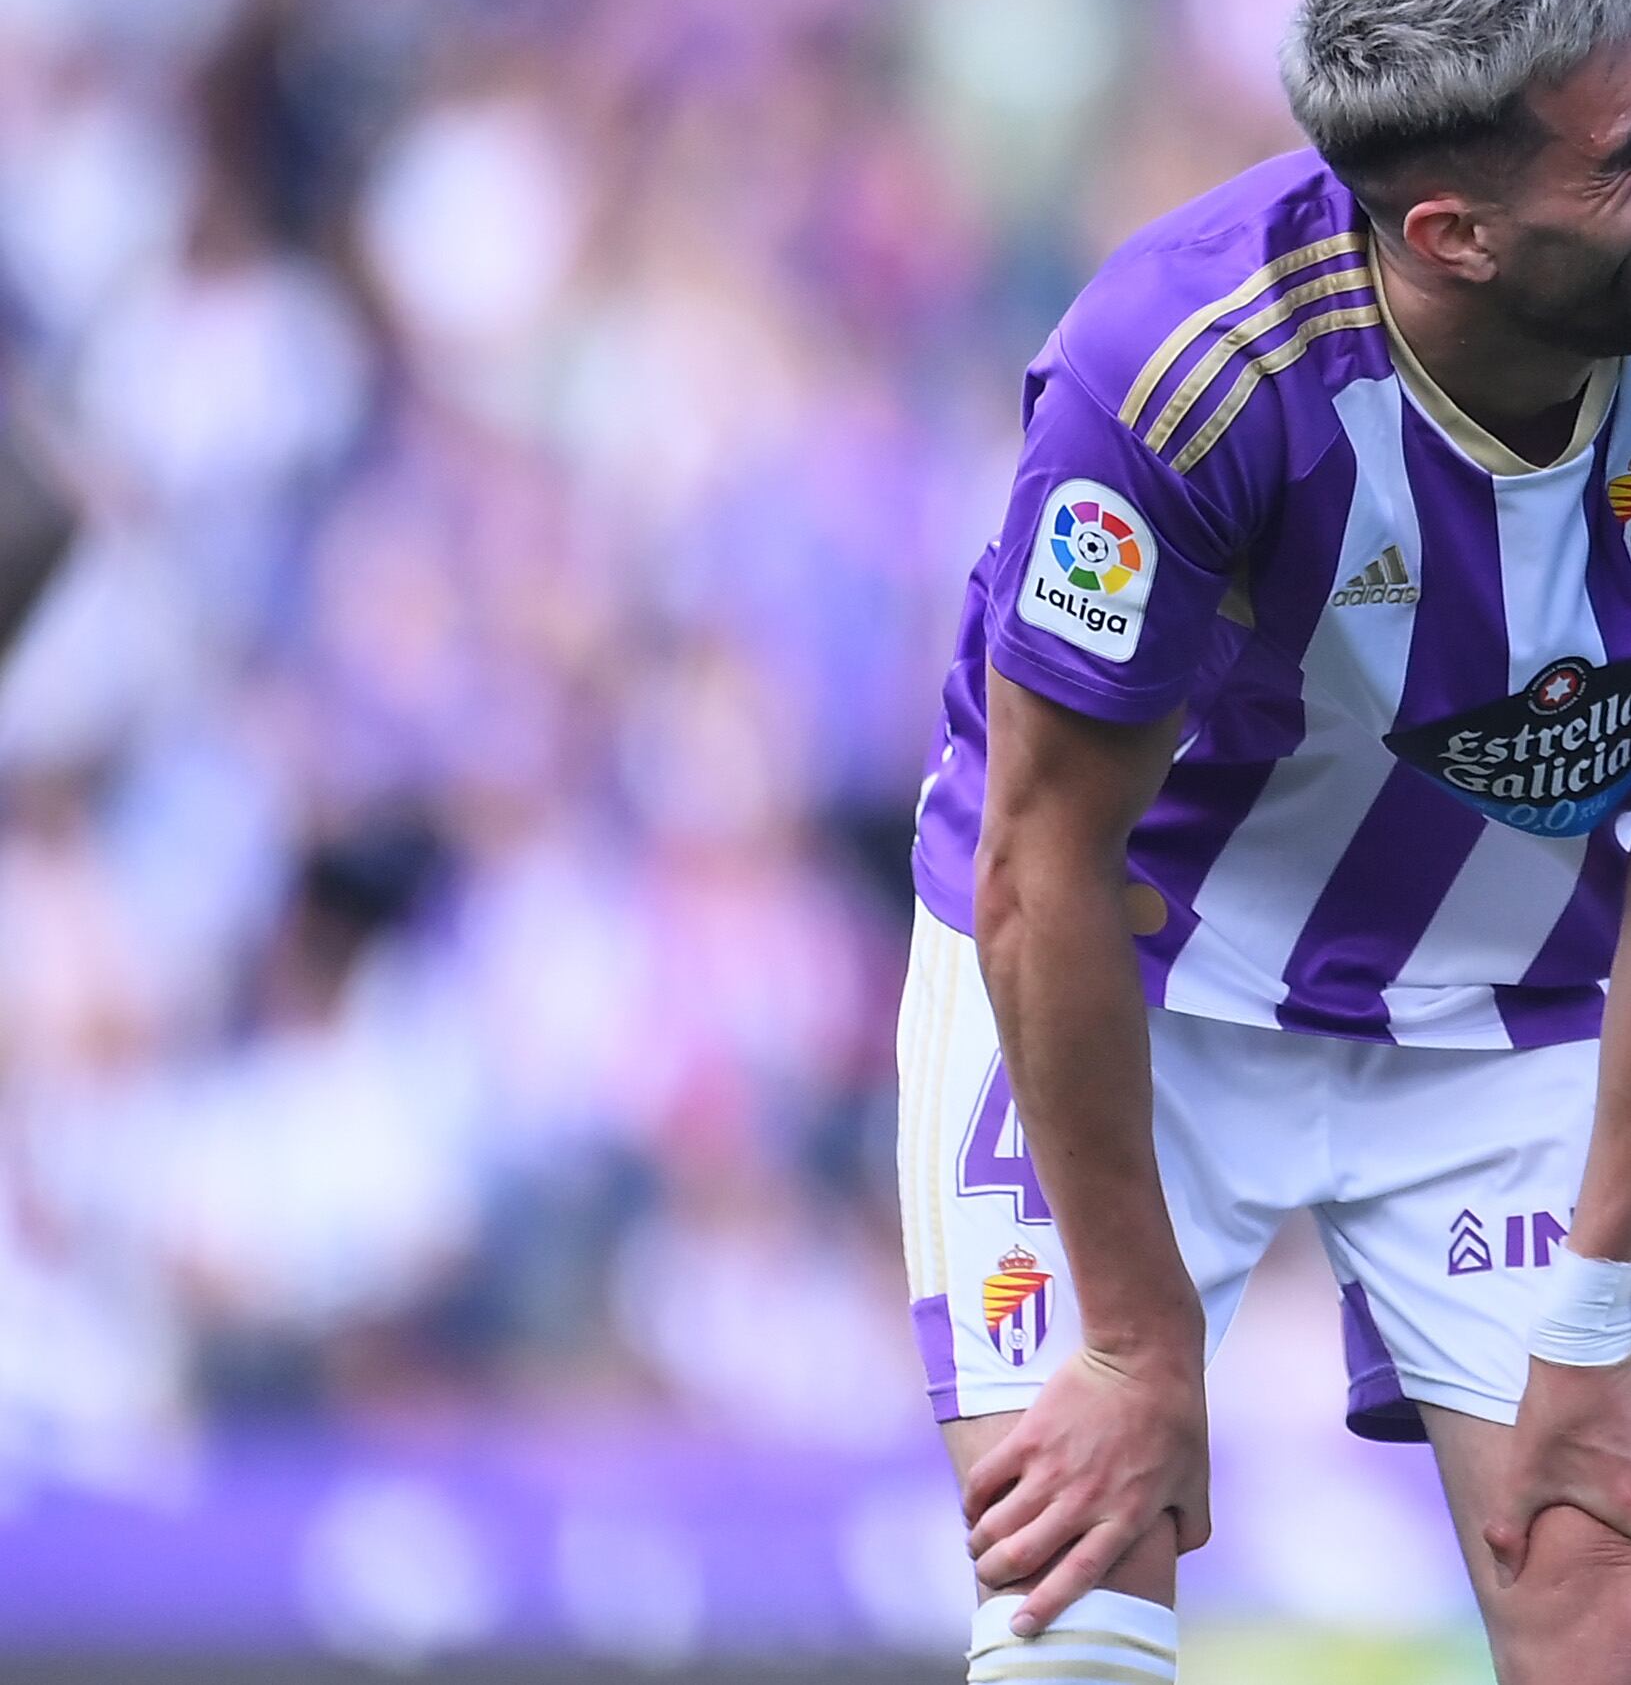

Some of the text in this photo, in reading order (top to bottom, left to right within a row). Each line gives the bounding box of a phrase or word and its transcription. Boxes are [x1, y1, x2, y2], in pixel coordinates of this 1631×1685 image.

[1035, 577, 1128, 635] LaLiga
[1333, 586, 1417, 607] adidas
[1443, 739, 1631, 799] Galicia
[956, 1048, 1053, 1226] 4
